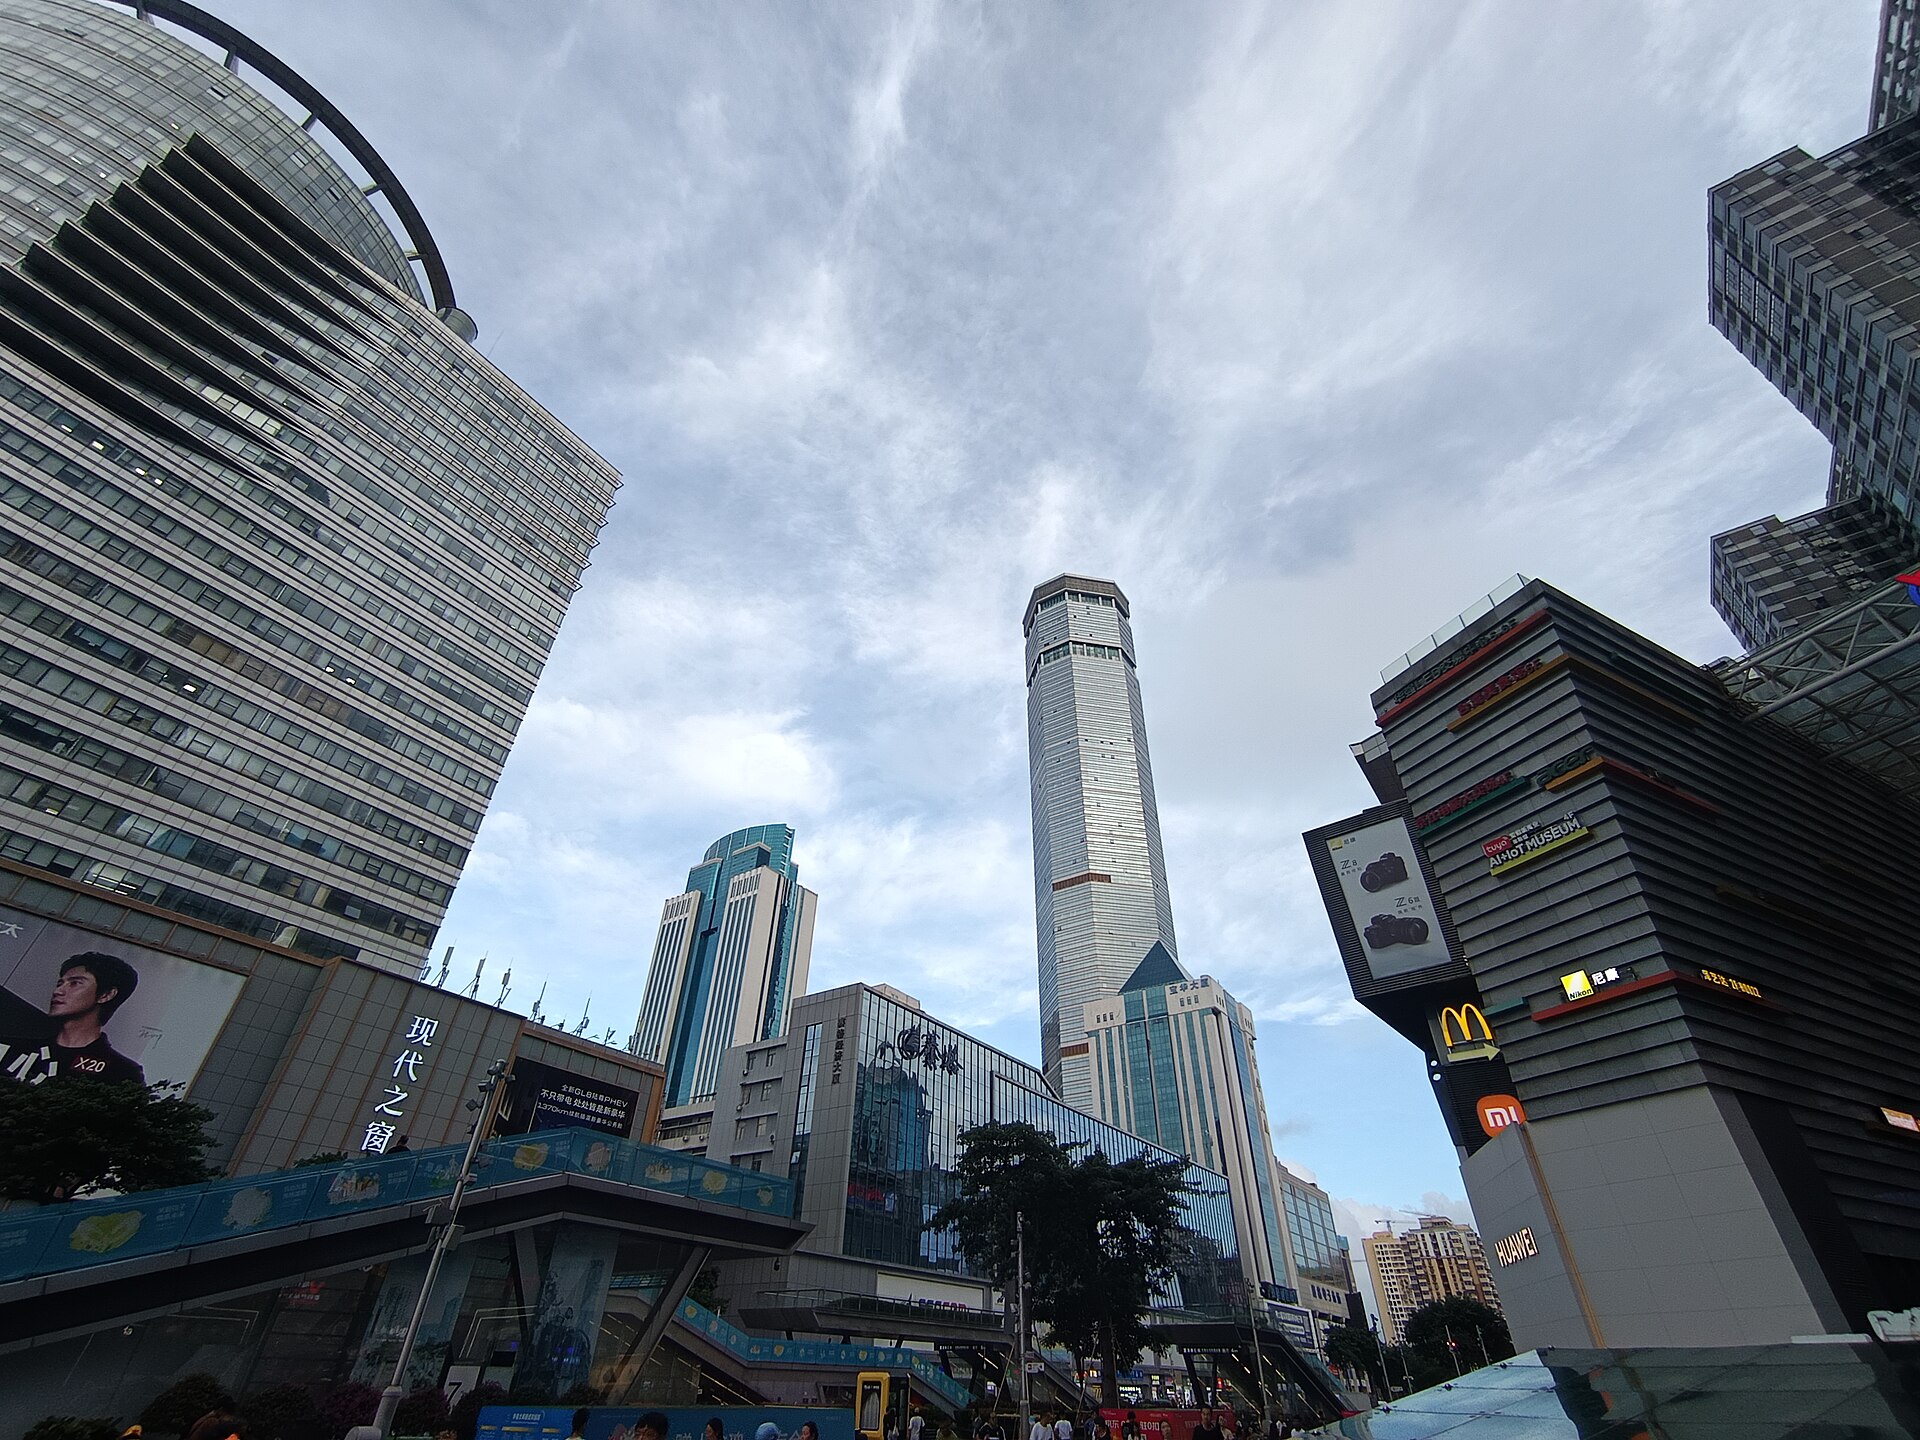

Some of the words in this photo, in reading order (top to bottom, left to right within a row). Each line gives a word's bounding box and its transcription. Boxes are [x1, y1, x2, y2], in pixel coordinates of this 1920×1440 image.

[1536, 746, 1595, 786] acer
[1486, 839, 1507, 853] tuya
[1490, 843, 1525, 867] AI+IoT
[1525, 817, 1581, 851] MUSEUM
[1569, 988, 1592, 999] Nikon
[74, 1056, 106, 1073] X20
[361, 1015, 439, 1155] 现代之窗
[540, 1088, 572, 1106] 不只带电
[573, 1097, 626, 1119] 处处皆是新豪华
[1494, 1226, 1539, 1267] HUAWEI
